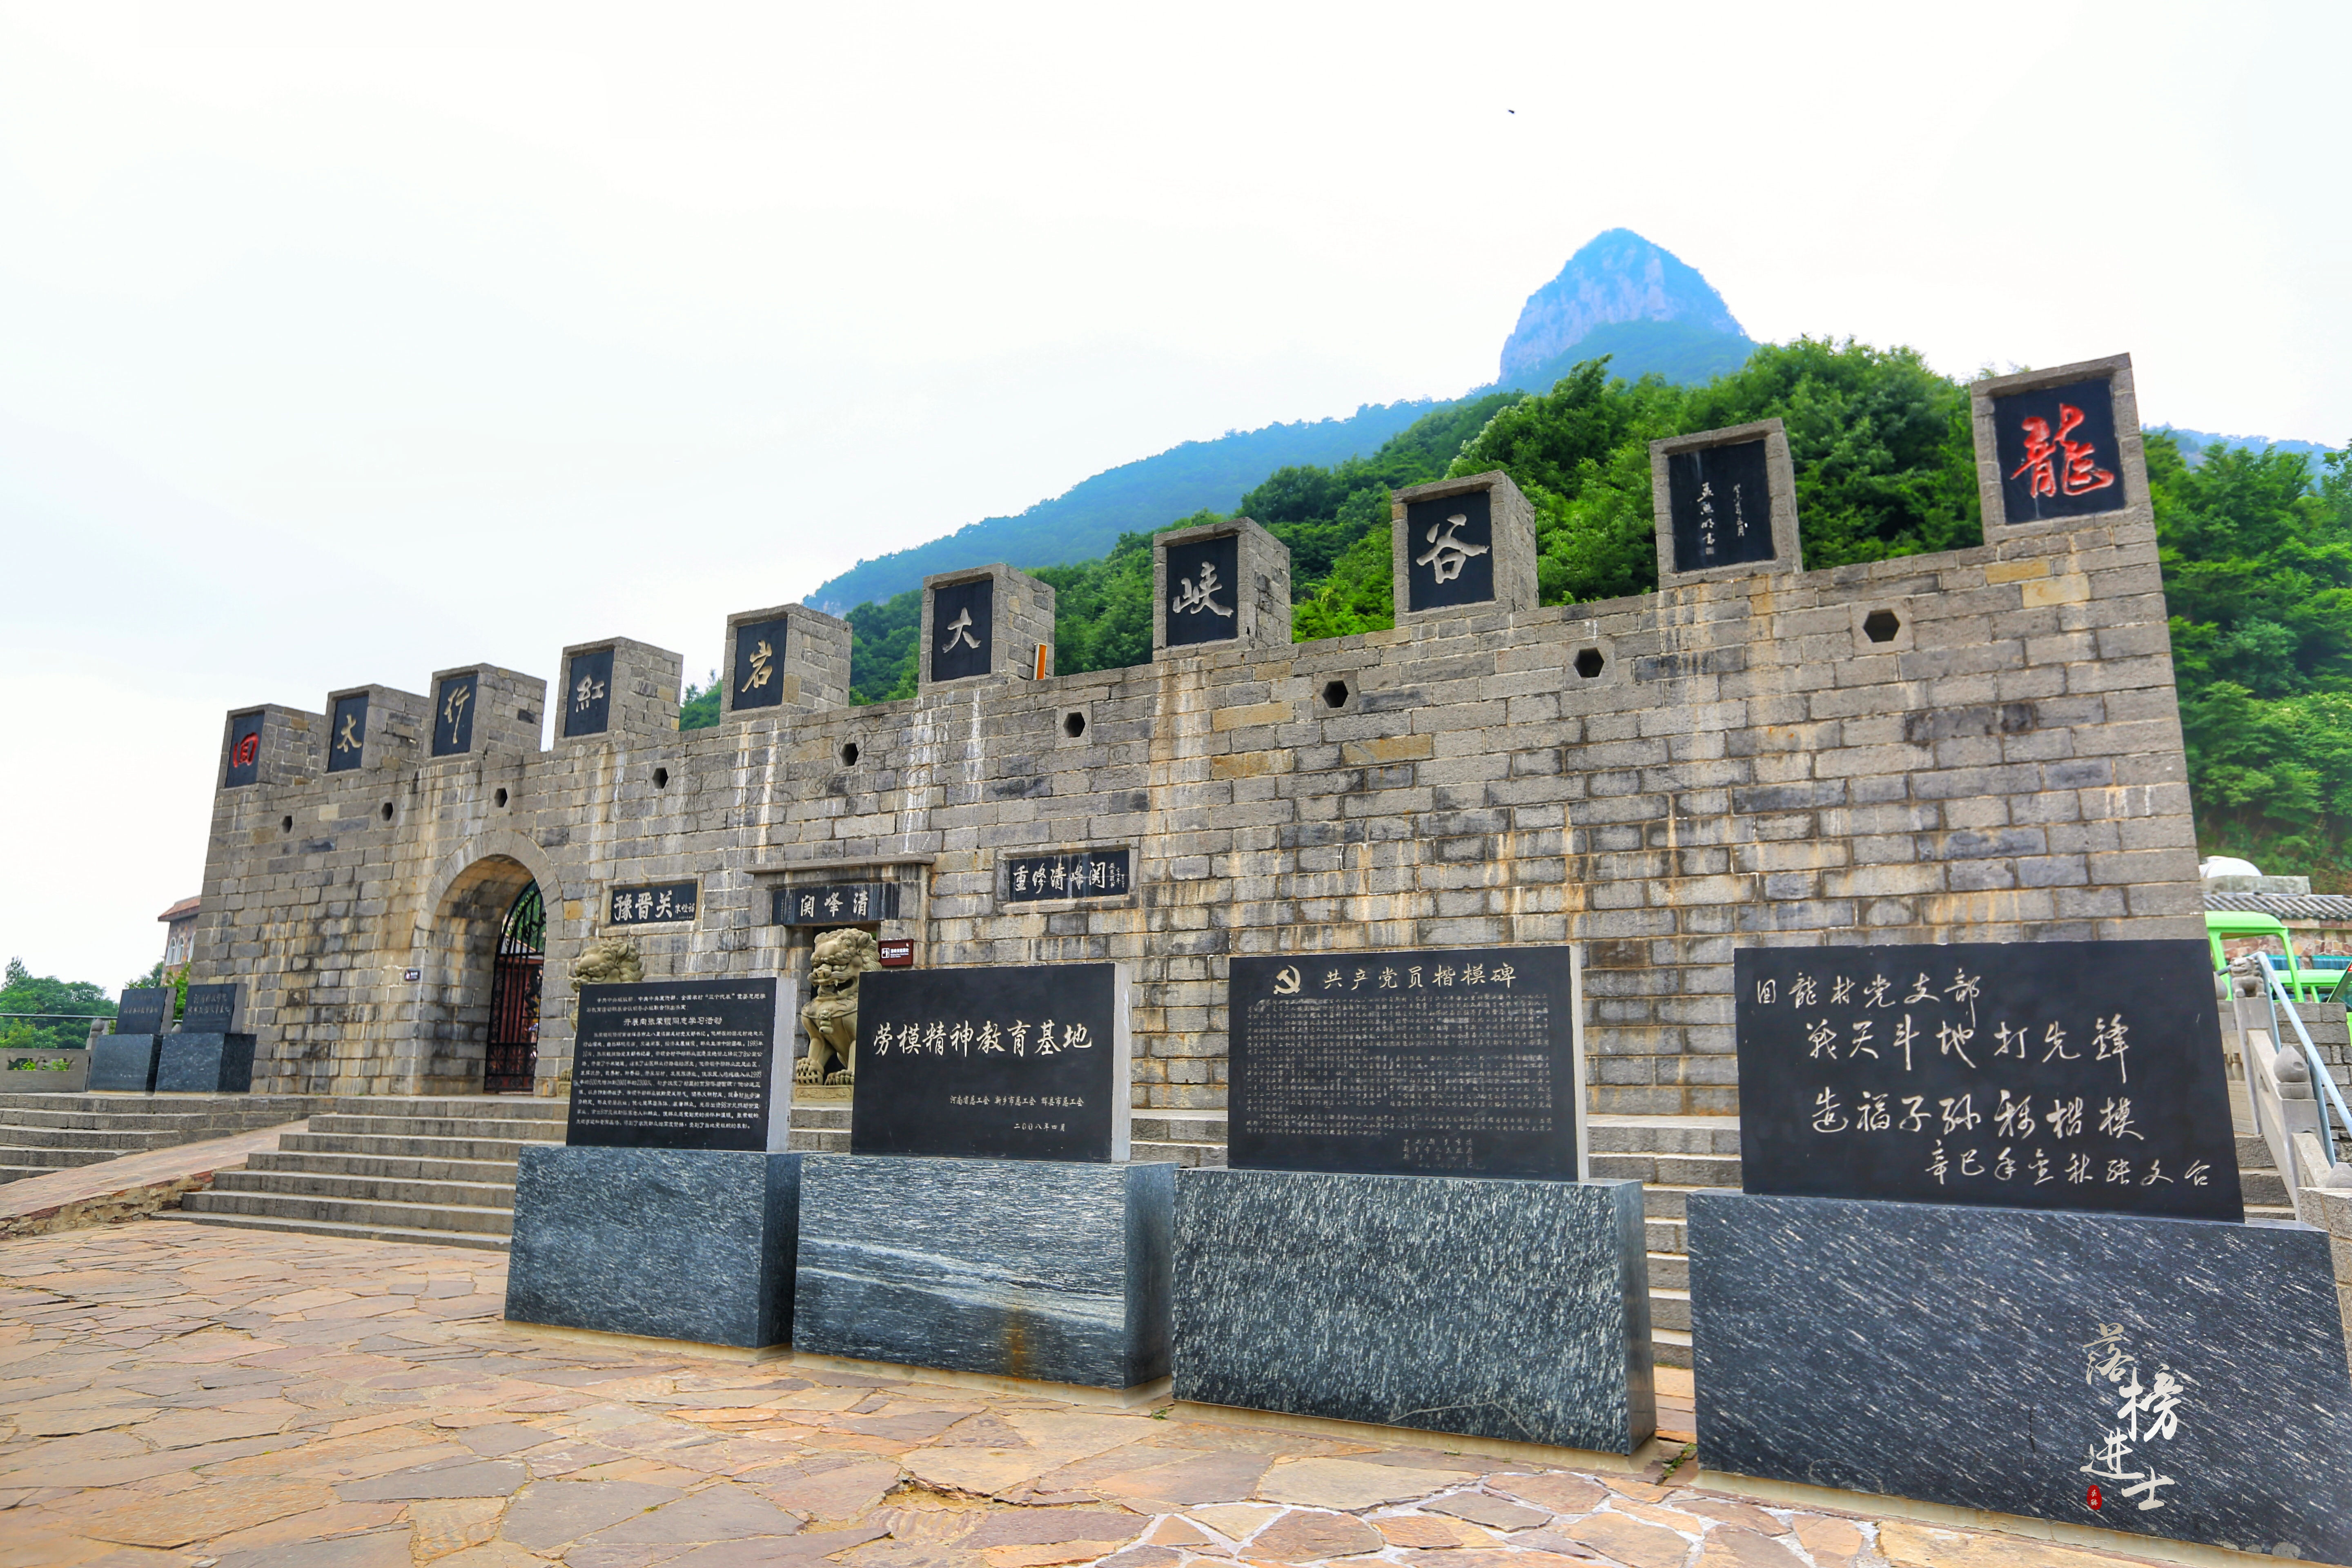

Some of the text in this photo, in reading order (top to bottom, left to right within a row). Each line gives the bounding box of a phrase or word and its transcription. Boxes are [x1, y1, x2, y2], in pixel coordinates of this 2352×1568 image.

[1416, 513, 1489, 584] 谷
[942, 607, 982, 653] 大
[741, 639, 773, 693] 岩
[337, 713, 363, 753] 太
[443, 684, 470, 744] 行
[232, 732, 259, 768] 回
[1323, 962, 1517, 989] 共产党员楷模碑
[873, 1019, 1093, 1057] 劳模精神教育基地
[950, 1095, 1085, 1108] 河南省总工会 新乡市总工会 辉县市总工会
